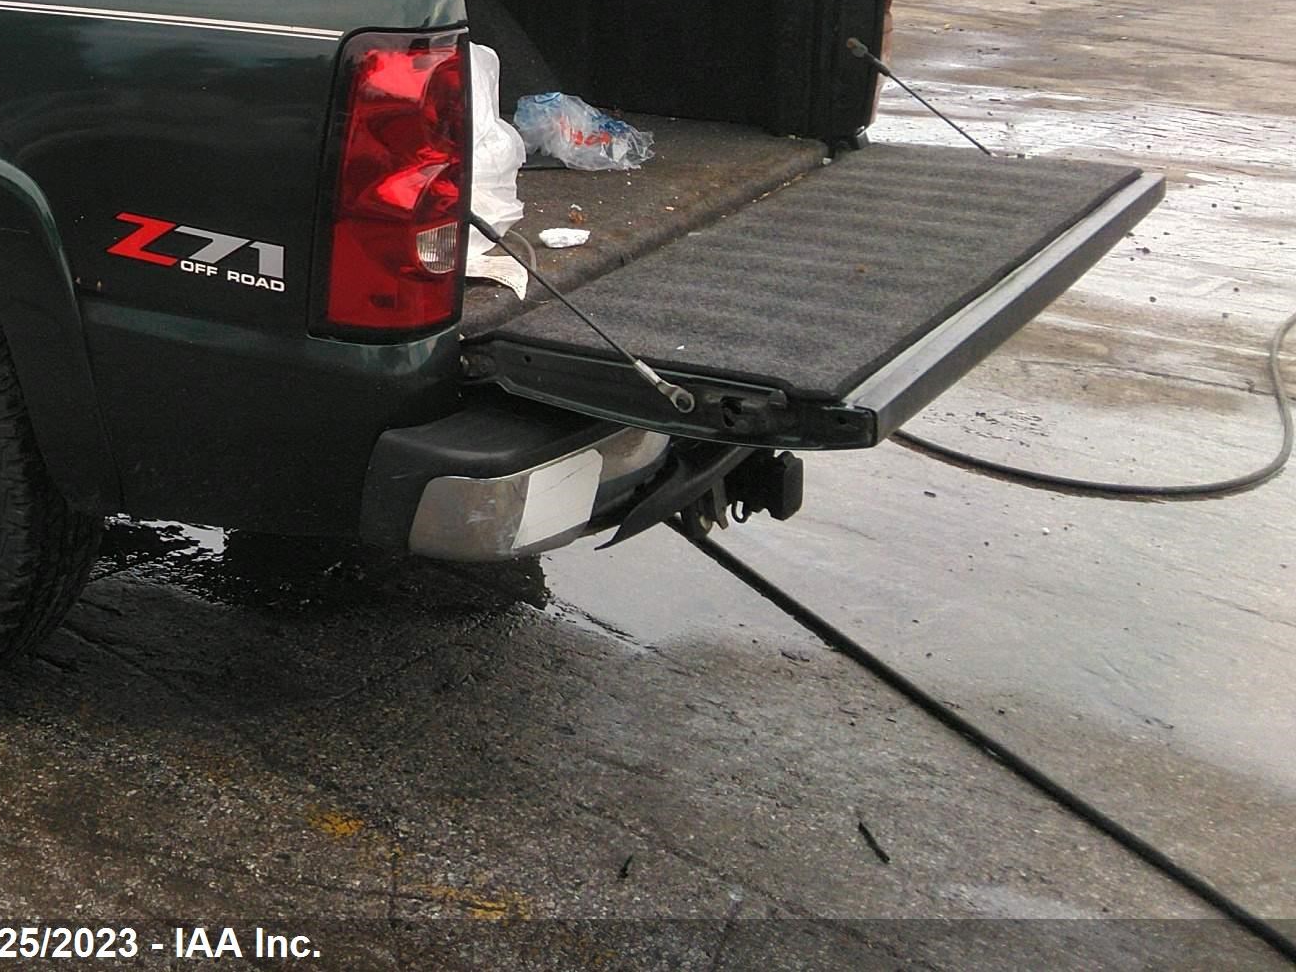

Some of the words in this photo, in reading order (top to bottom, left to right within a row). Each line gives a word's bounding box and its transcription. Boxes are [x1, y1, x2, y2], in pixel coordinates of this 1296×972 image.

[106, 212, 285, 279] Z71
[180, 260, 218, 277] OFF
[226, 270, 285, 292] ROAD
